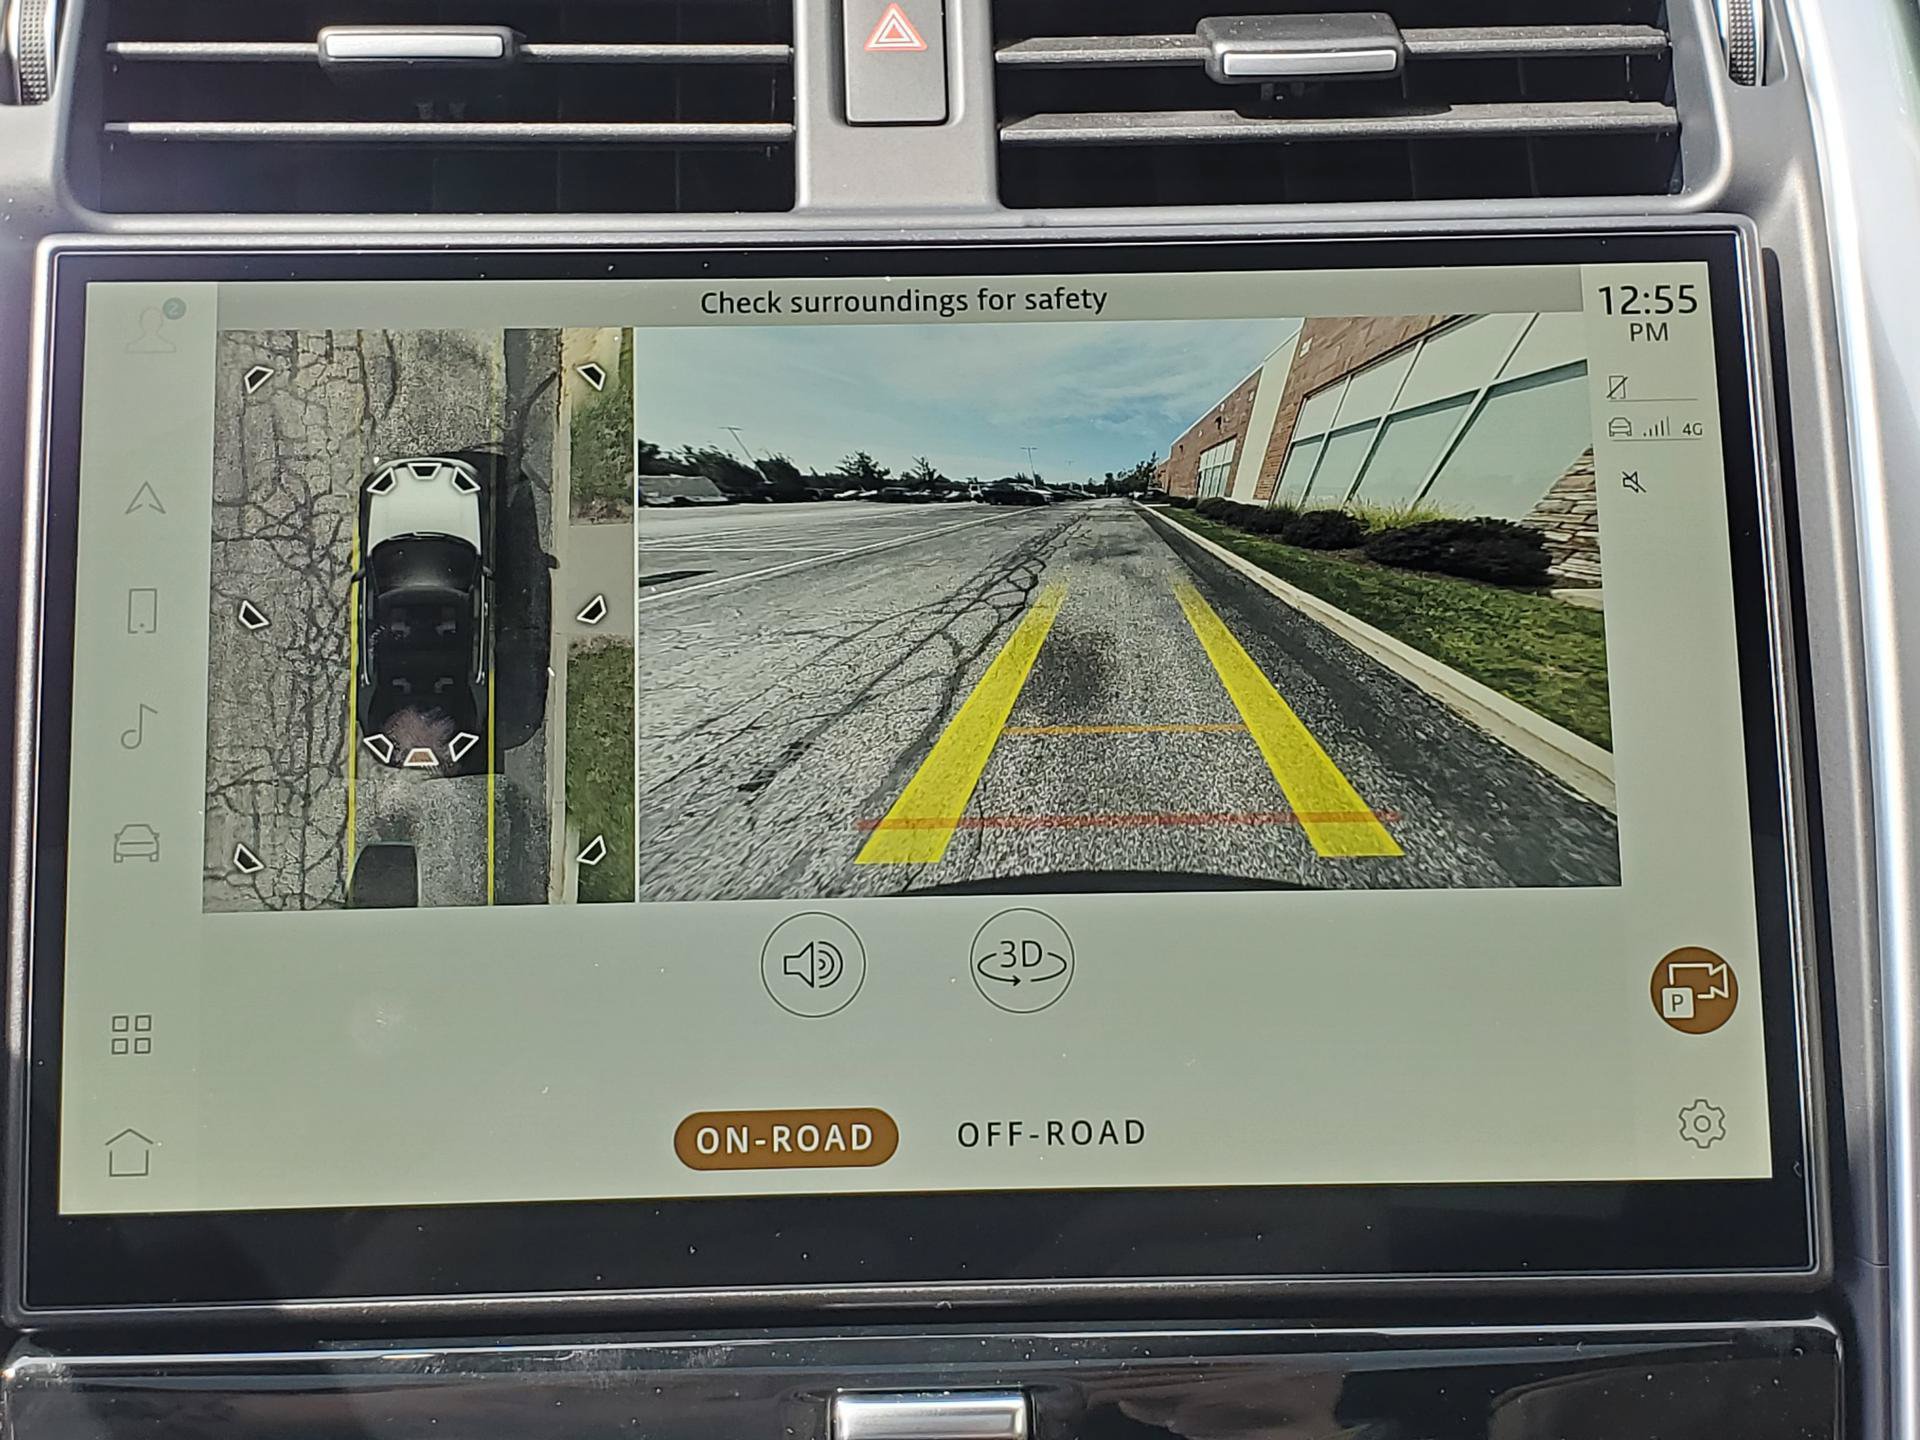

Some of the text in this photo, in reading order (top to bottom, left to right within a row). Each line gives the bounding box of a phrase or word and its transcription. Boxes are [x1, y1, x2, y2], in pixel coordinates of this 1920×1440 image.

[701, 286, 1109, 317] Check surroundings for safety
[1598, 284, 1698, 315] 12:55
[1629, 322, 1669, 342] PM
[1682, 422, 1703, 436] 4G
[1000, 940, 1043, 968] 3D
[1671, 993, 1685, 1013] P
[695, 1123, 874, 1154] ON-ROAD
[957, 1118, 1146, 1147] OFF-ROAD
